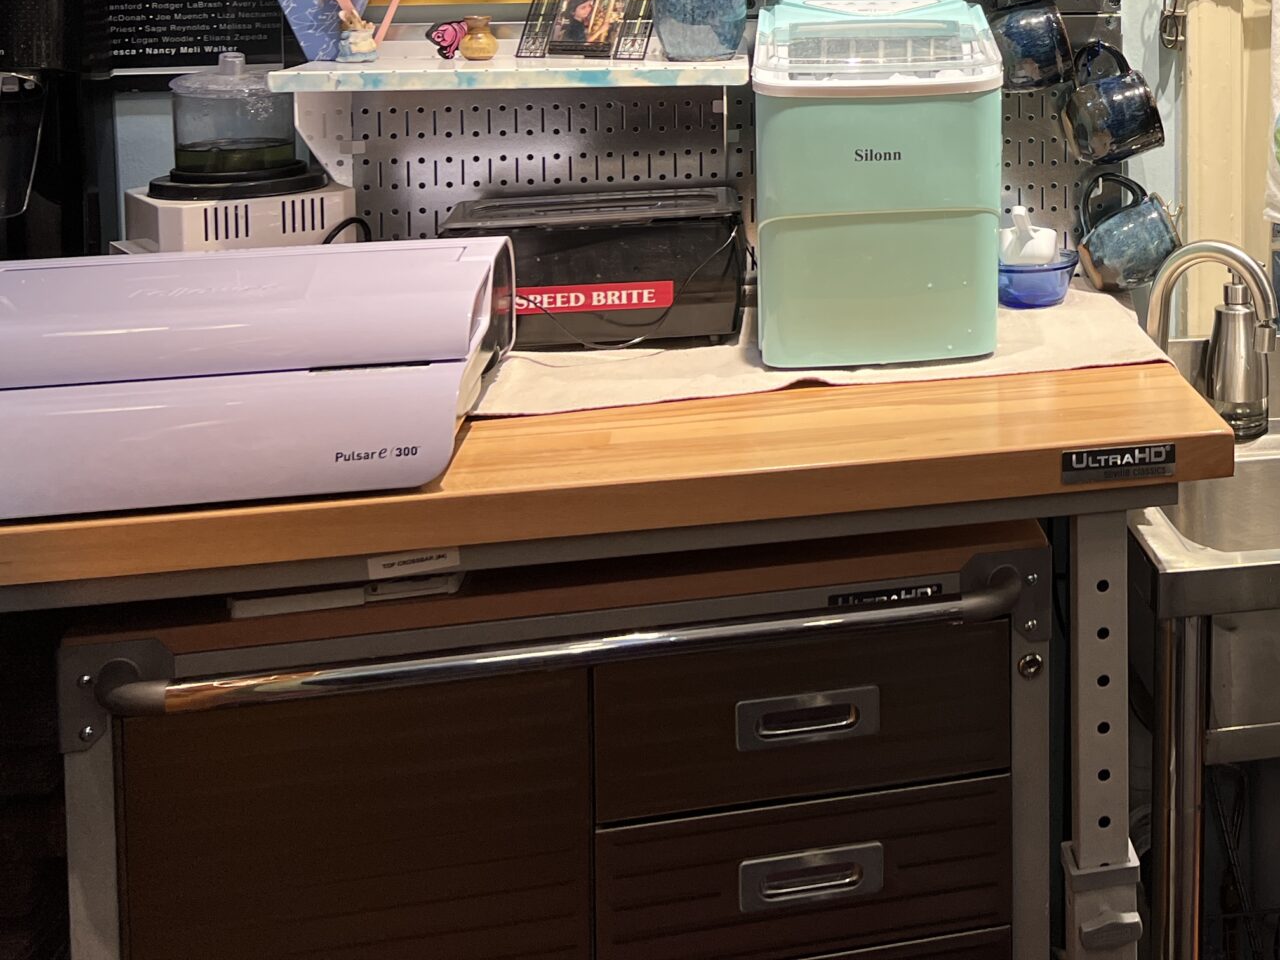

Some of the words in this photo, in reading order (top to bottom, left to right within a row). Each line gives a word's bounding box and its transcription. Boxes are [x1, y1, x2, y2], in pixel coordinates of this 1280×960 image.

[151, 2, 184, 11] Rodger
[154, 13, 172, 22] Joe
[174, 12, 209, 21] Muench
[110, 25, 137, 33] Priest
[169, 23, 211, 33] Reynolds
[130, 36, 159, 46] Logan
[112, 48, 137, 56] esca
[145, 46, 177, 56] Nancy
[179, 45, 201, 54] Meli
[203, 44, 239, 54] Walker
[854, 148, 902, 162] Silonn
[515, 291, 586, 309] SPEED
[591, 288, 656, 306] BRITE
[335, 451, 377, 463] Pulsar
